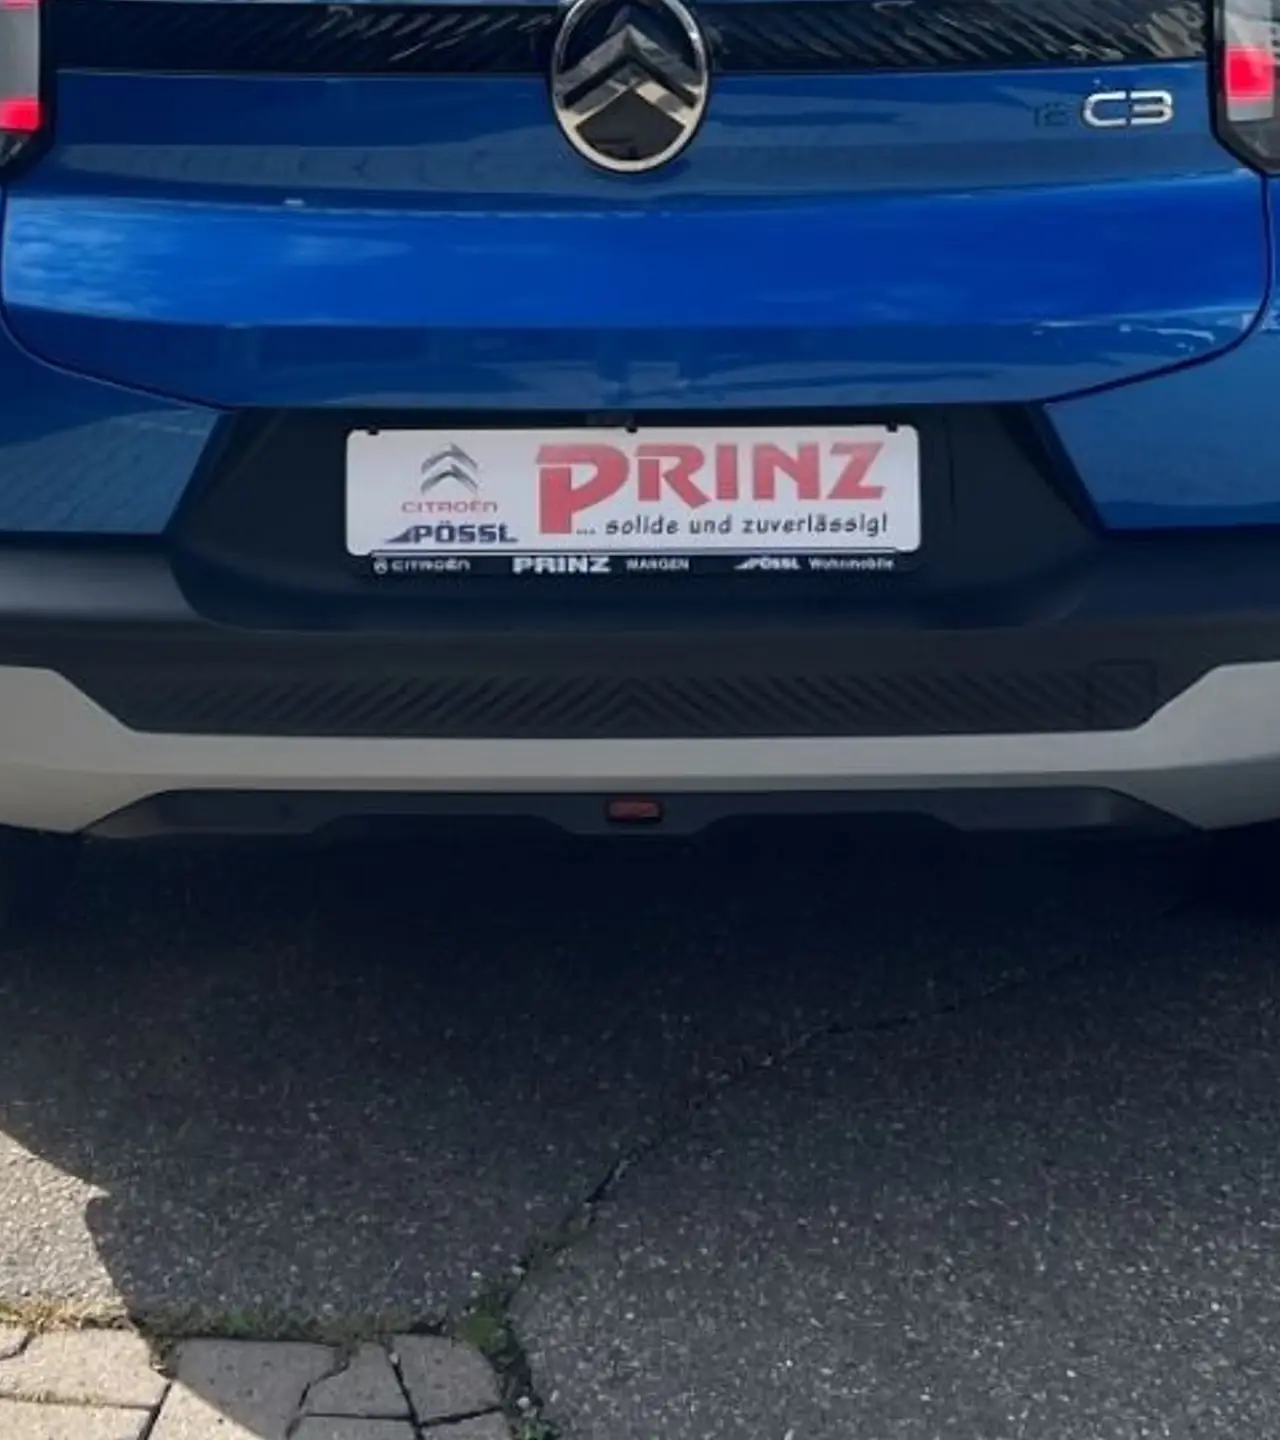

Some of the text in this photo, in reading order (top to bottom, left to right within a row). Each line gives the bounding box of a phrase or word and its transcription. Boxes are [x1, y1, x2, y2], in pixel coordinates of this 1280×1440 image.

[1083, 90, 1173, 127] C3
[535, 442, 885, 535] PRINZ
[412, 520, 519, 544] PÖSSL
[605, 514, 679, 536] solide
[689, 514, 733, 536] und
[742, 512, 888, 538] zuverlässig!
[512, 556, 612, 574] PRINZ
